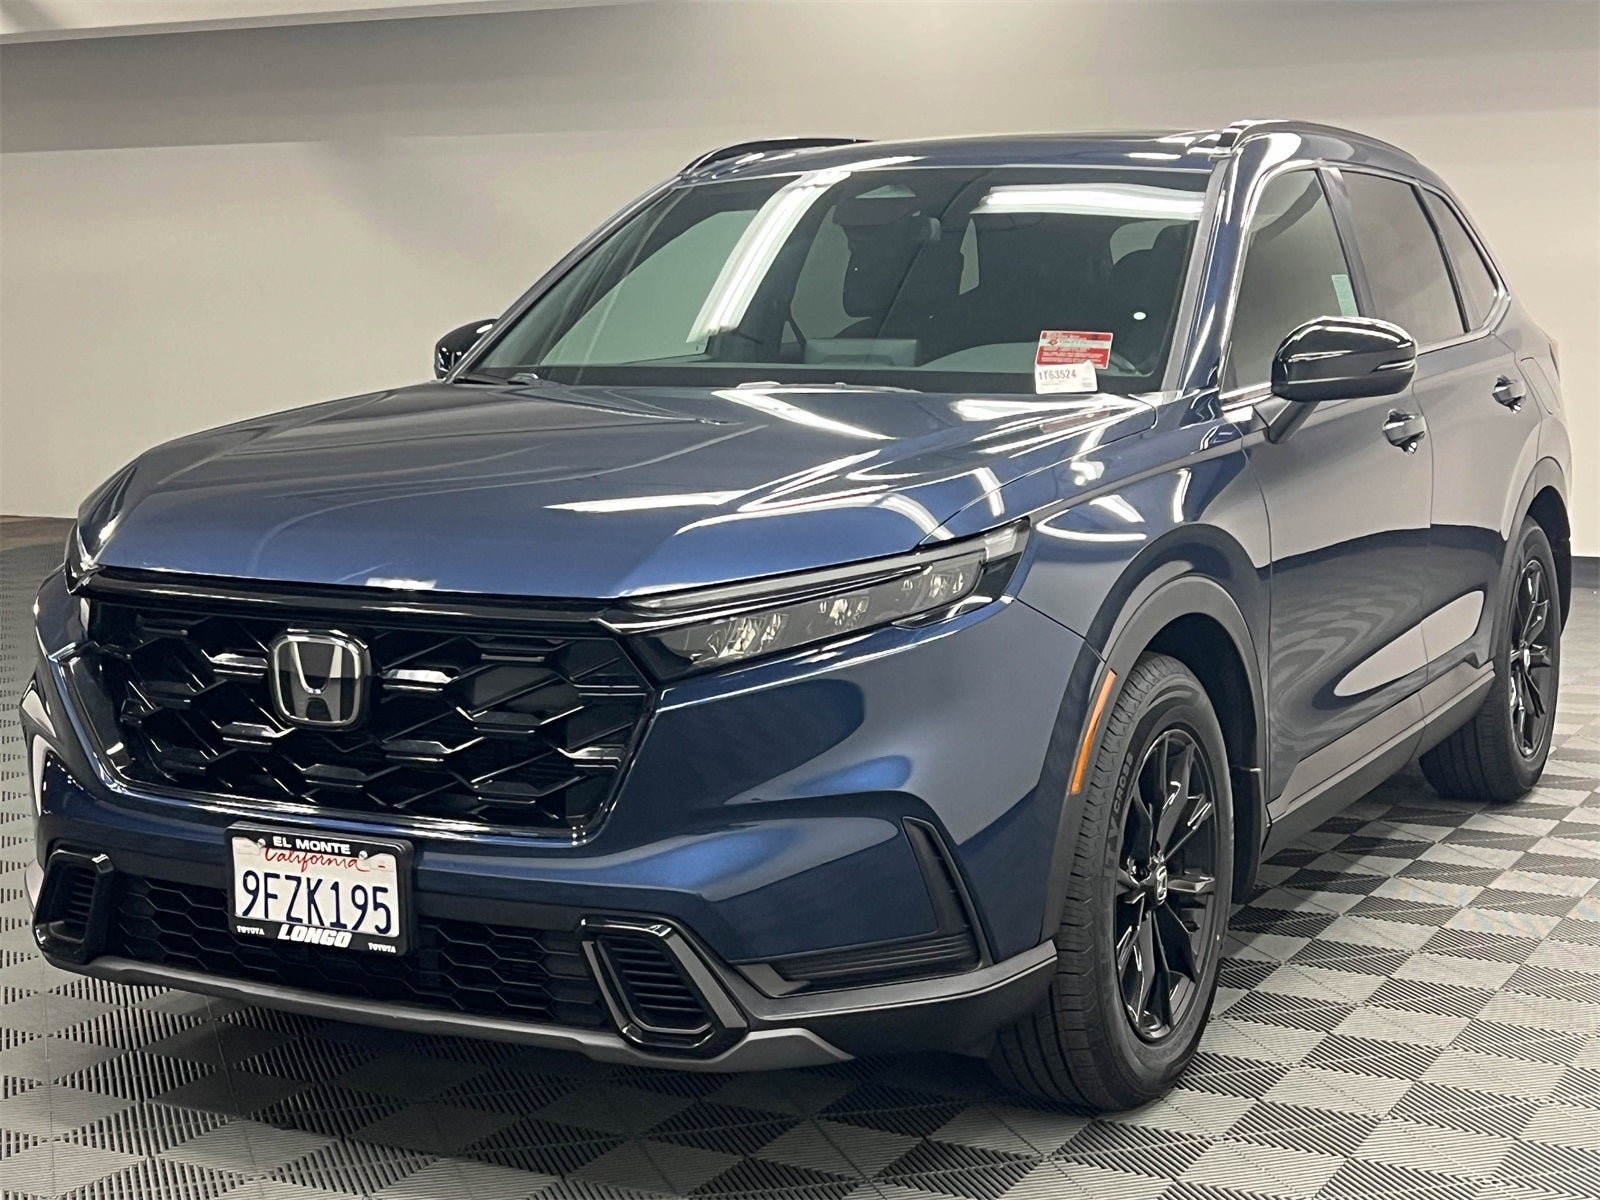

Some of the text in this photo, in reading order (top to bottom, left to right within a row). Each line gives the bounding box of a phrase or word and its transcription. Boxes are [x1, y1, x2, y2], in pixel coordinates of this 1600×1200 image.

[272, 836, 351, 855] EL MONTE
[264, 848, 370, 872] California
[242, 869, 392, 935] 9FZK195
[236, 925, 265, 936] TOYOTA
[277, 923, 353, 948] LONGO
[367, 942, 397, 954] TOYOTA
